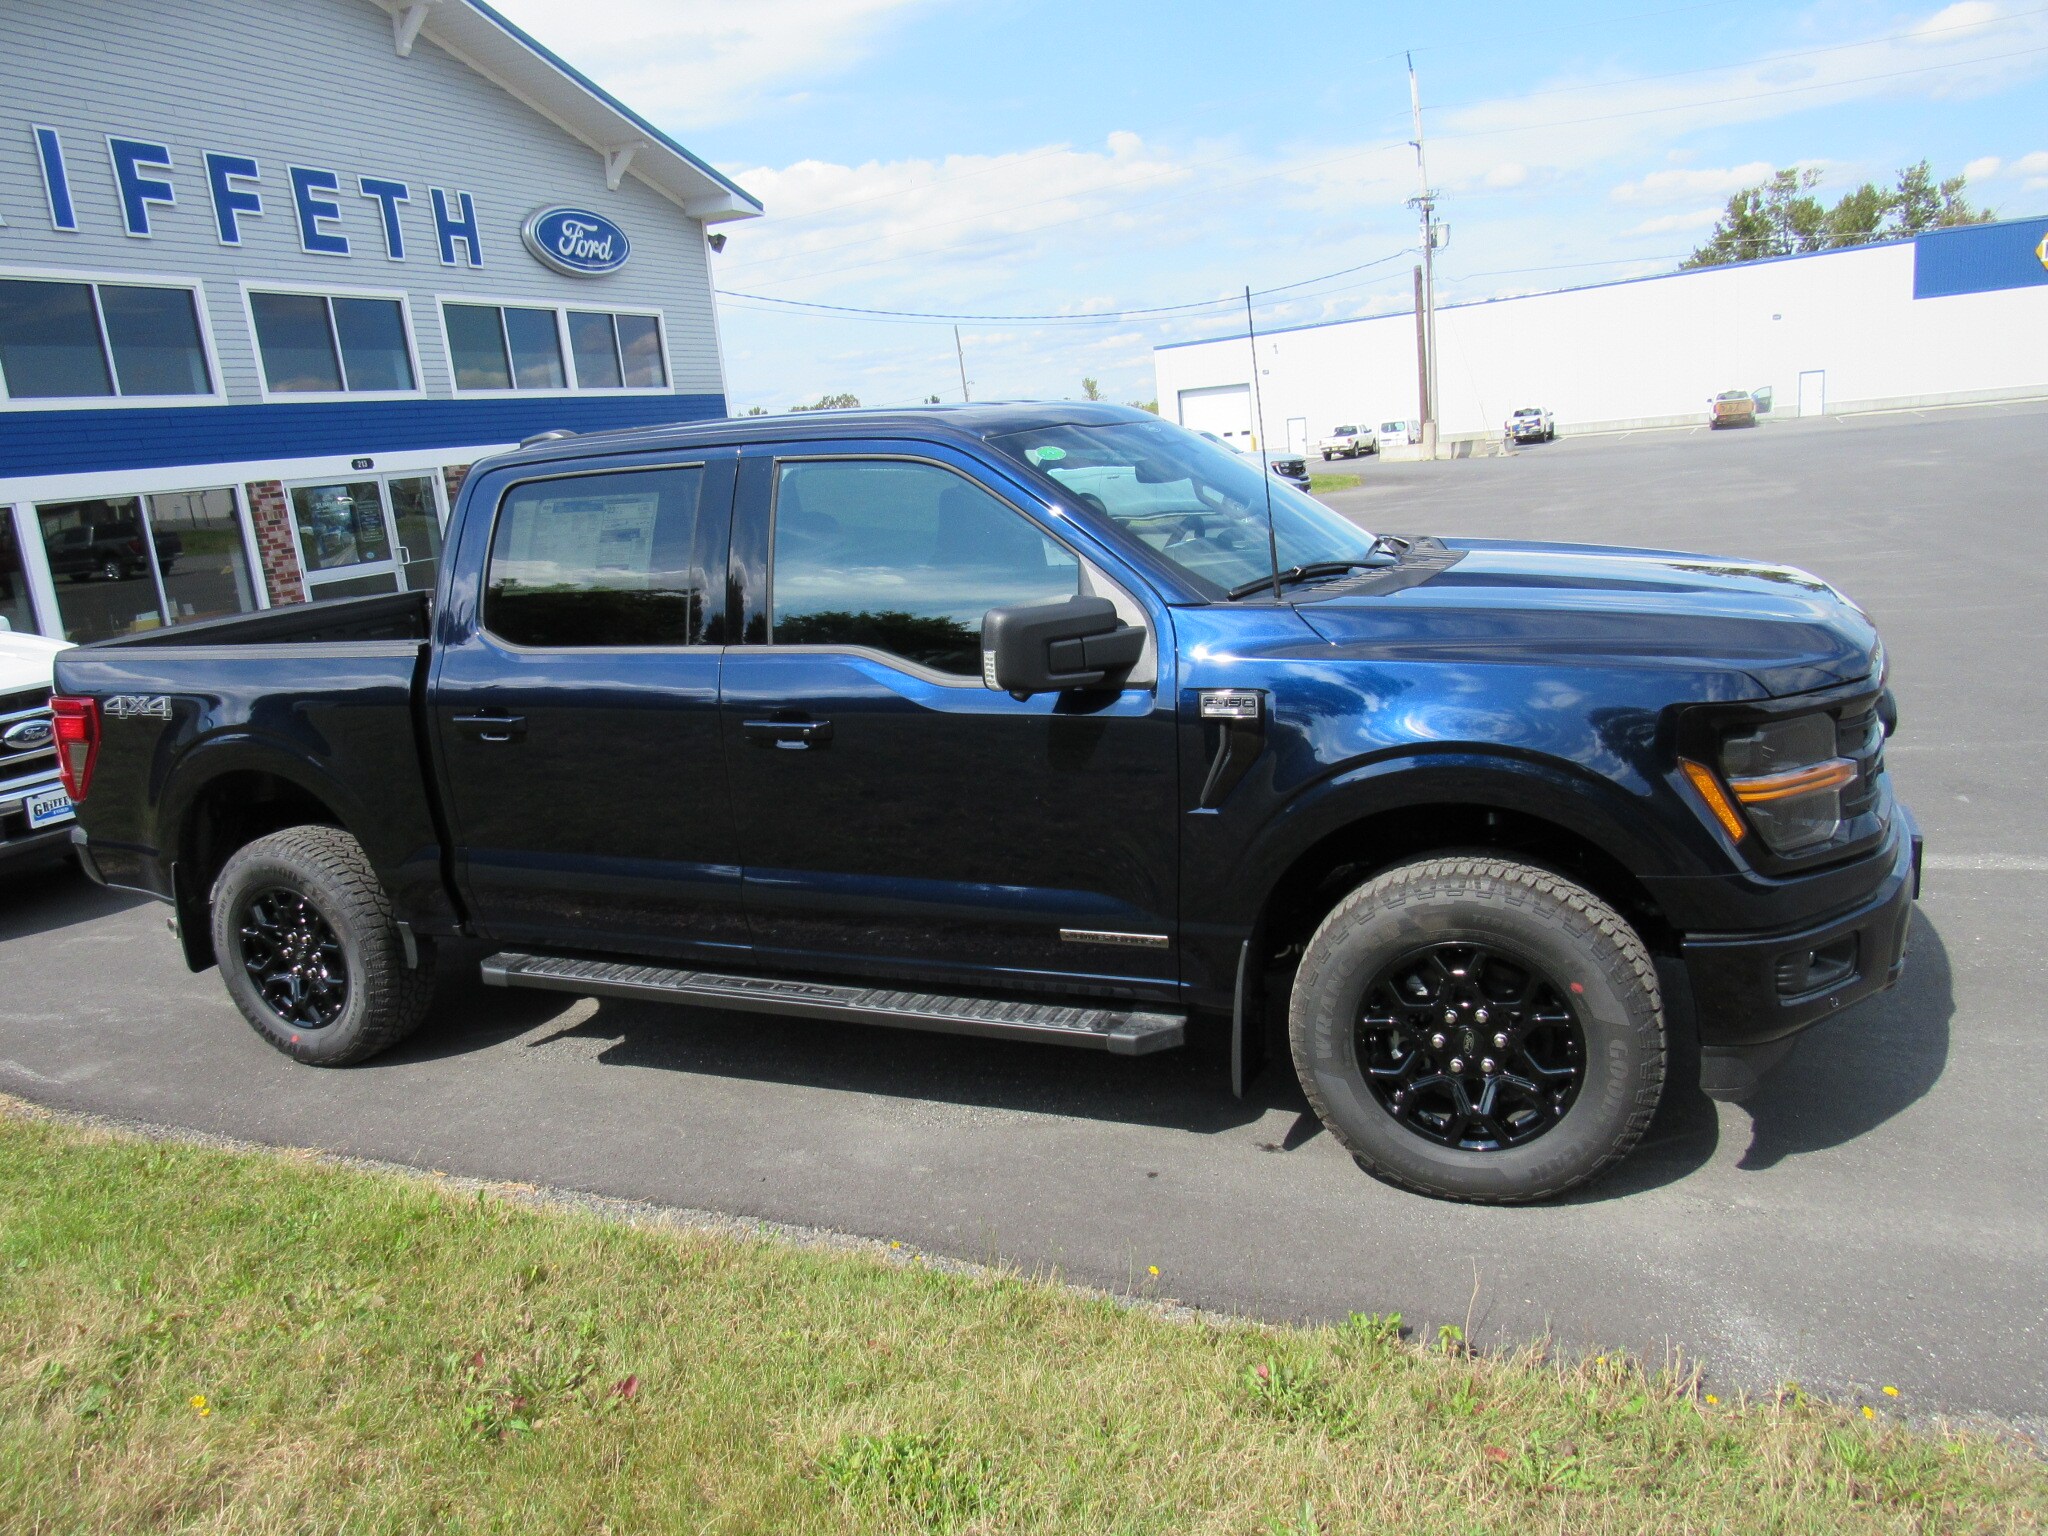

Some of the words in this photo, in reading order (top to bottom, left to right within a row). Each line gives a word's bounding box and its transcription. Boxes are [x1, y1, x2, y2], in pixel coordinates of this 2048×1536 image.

[0, 122, 484, 269] IFFETH
[558, 219, 613, 261] Ford
[23, 726, 48, 741] Ford
